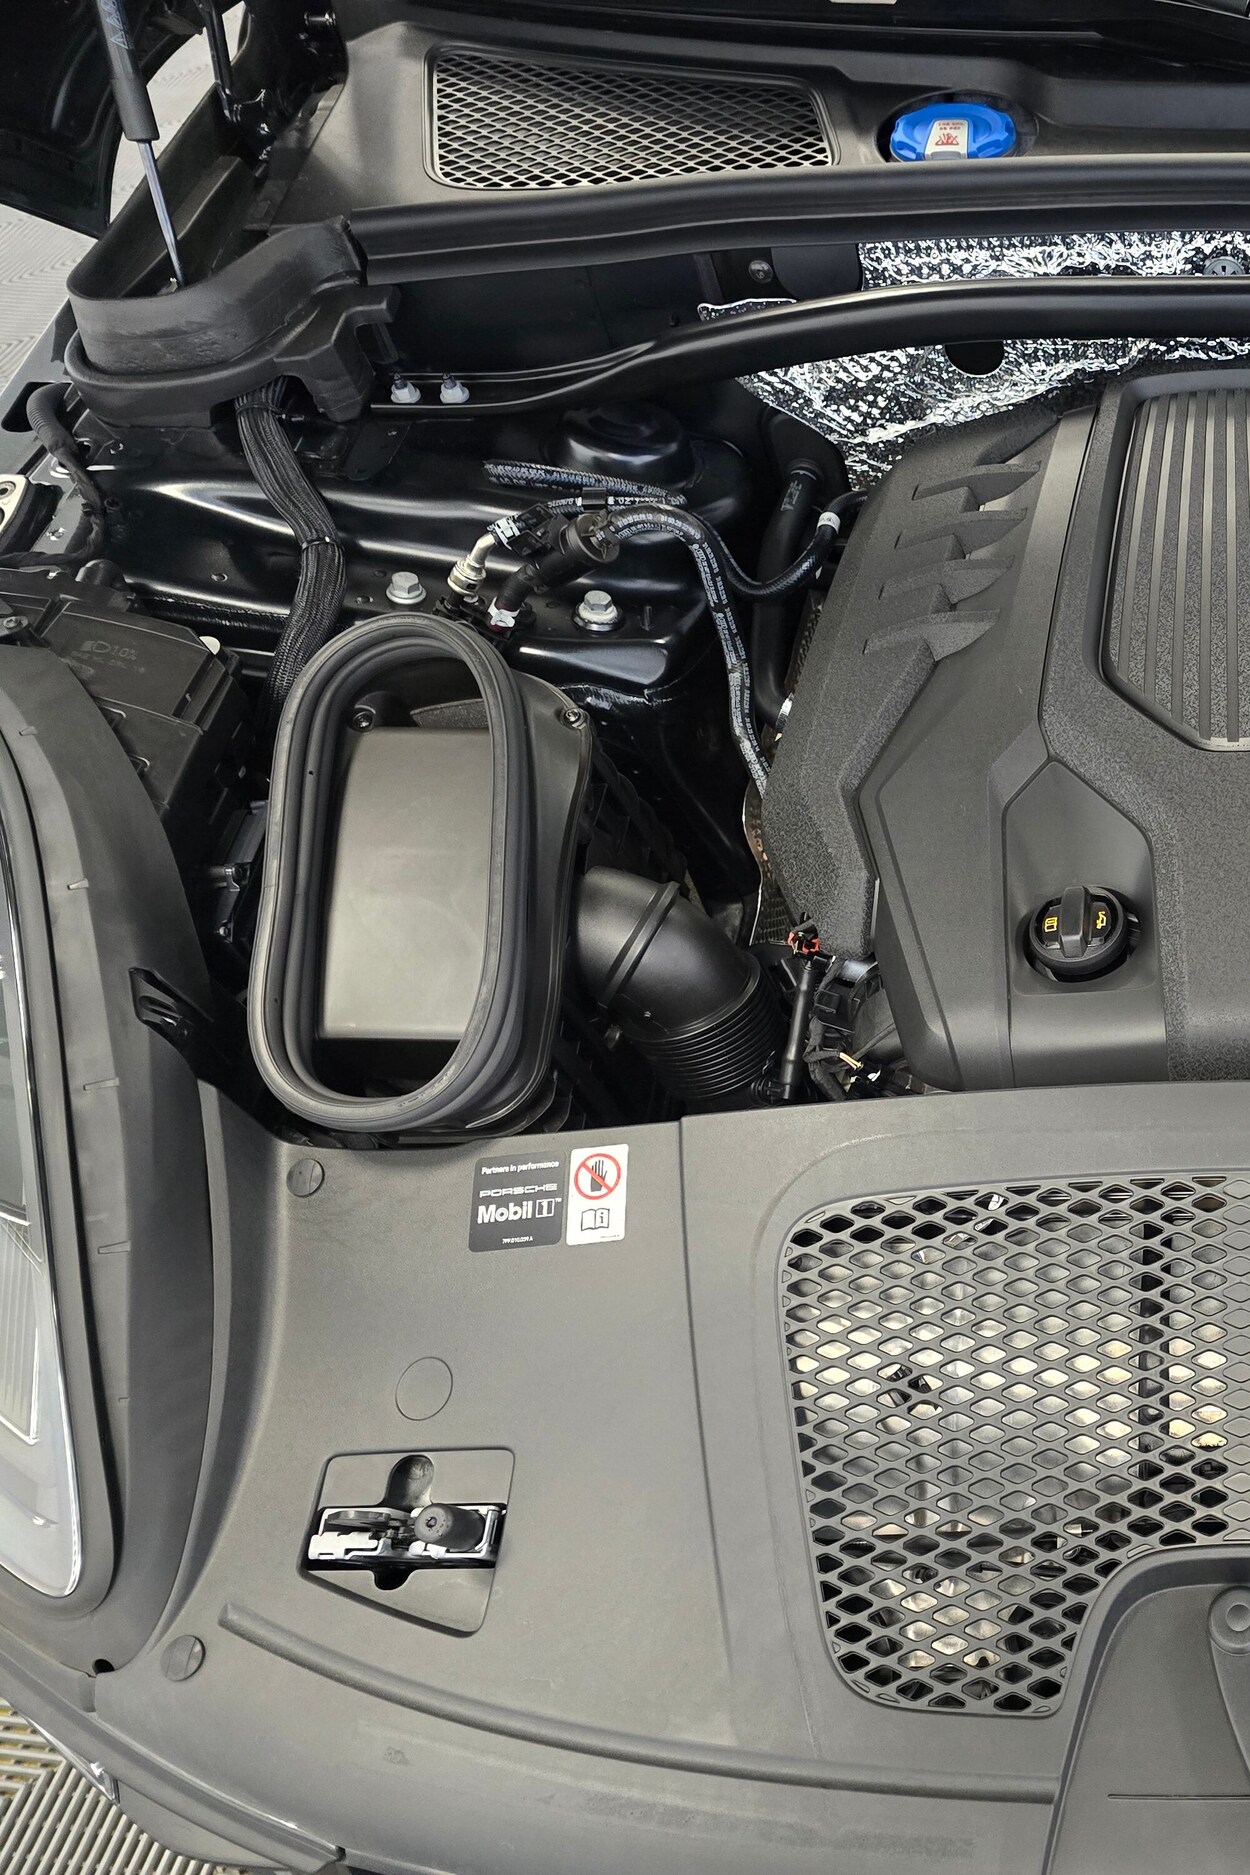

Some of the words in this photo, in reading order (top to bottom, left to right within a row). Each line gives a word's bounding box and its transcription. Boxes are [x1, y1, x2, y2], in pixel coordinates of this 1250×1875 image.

[481, 1165, 509, 1175] Partners
[510, 1163, 517, 1172] in
[518, 1161, 560, 1173] performance
[479, 1183, 558, 1198] PORSCHE
[477, 1200, 533, 1224] Mobil
